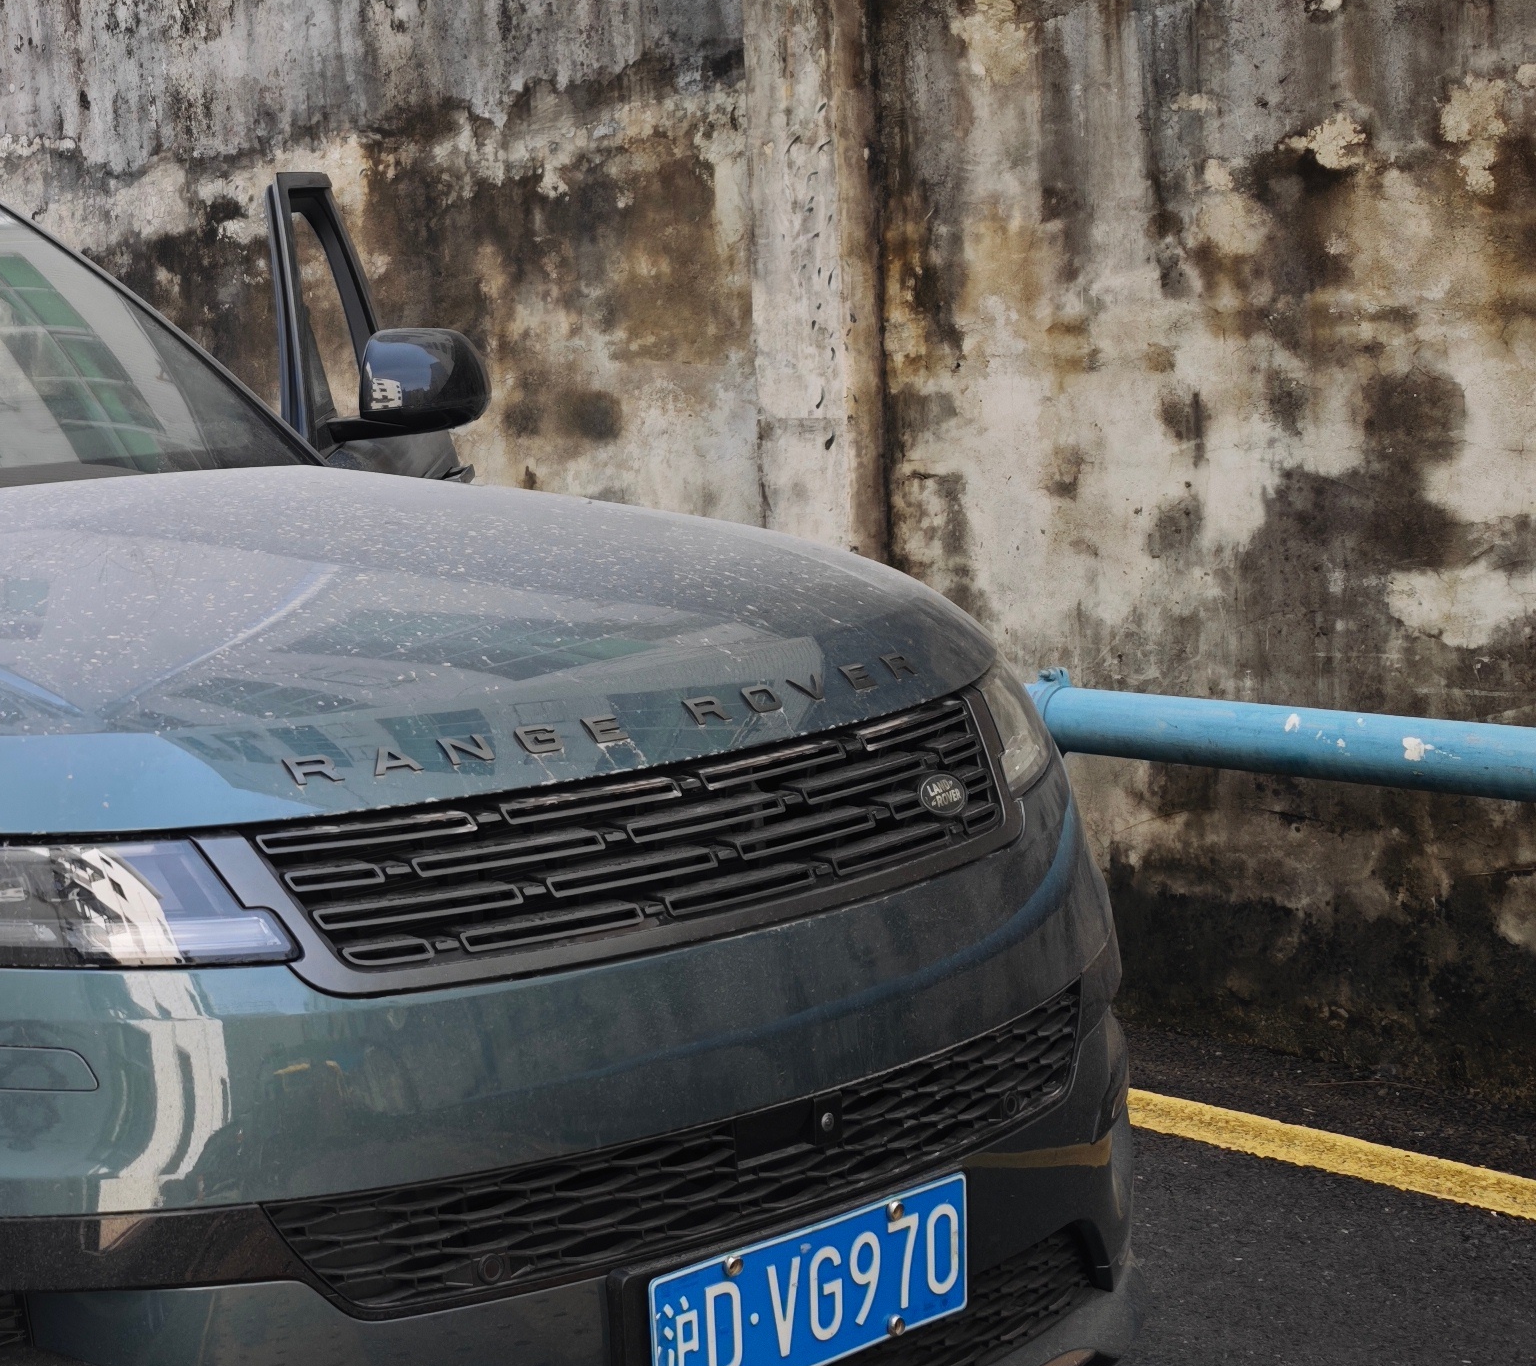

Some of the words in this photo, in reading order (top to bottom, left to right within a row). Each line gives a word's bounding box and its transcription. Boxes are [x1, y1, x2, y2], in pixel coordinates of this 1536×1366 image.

[281, 715, 629, 786] RANGE
[681, 652, 918, 726] ROVER
[926, 779, 951, 796] LAND
[934, 788, 962, 807] ROVER
